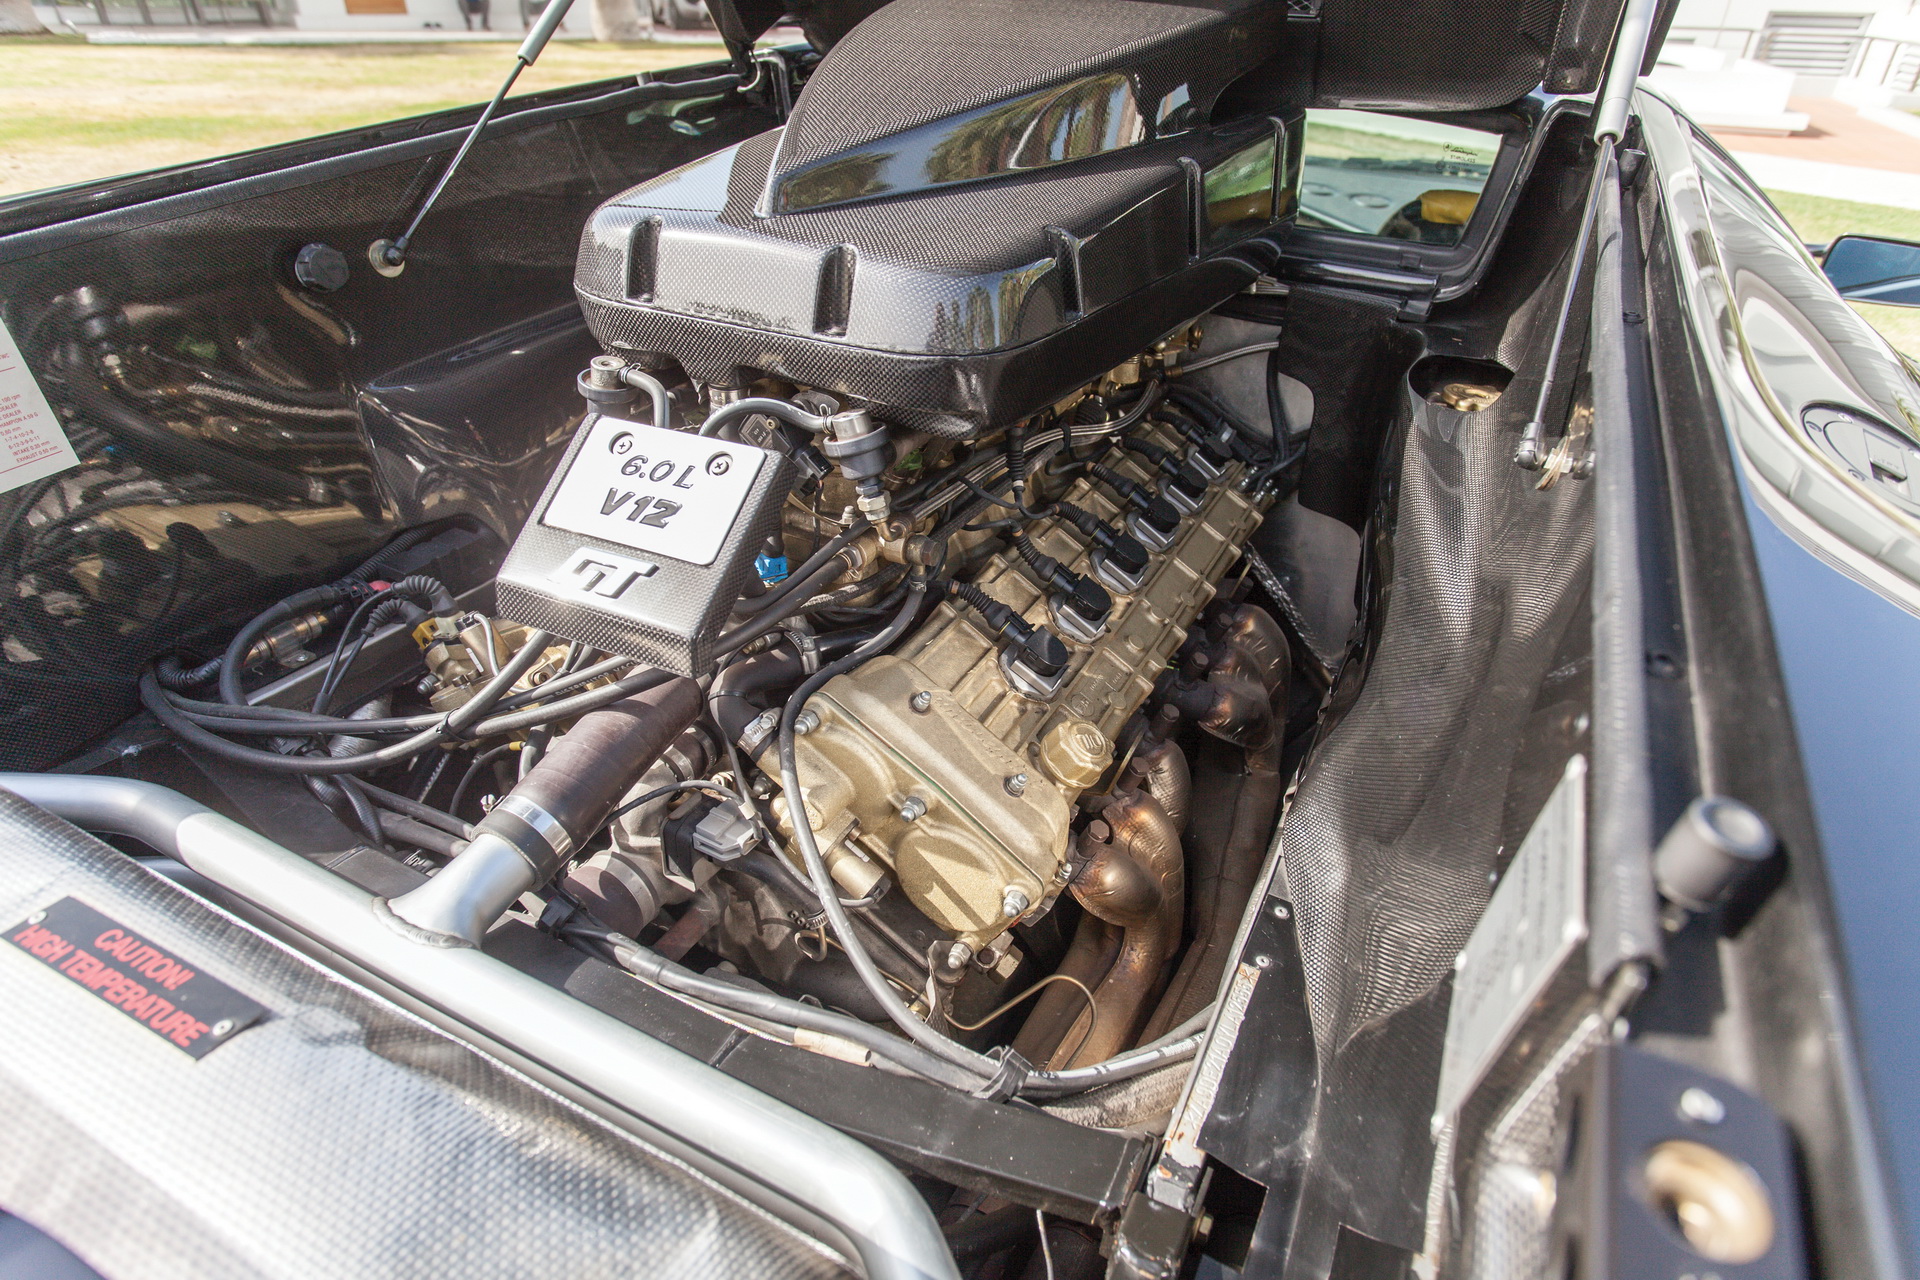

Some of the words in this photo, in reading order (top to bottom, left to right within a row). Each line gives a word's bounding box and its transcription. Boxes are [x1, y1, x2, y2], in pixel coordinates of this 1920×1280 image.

[620, 454, 676, 482] 6.0
[672, 465, 696, 489] L
[599, 487, 683, 529] V12
[93, 928, 195, 991] CAUTION!
[13, 924, 75, 963] HIGH
[58, 949, 210, 1048] TEMPERATURE
